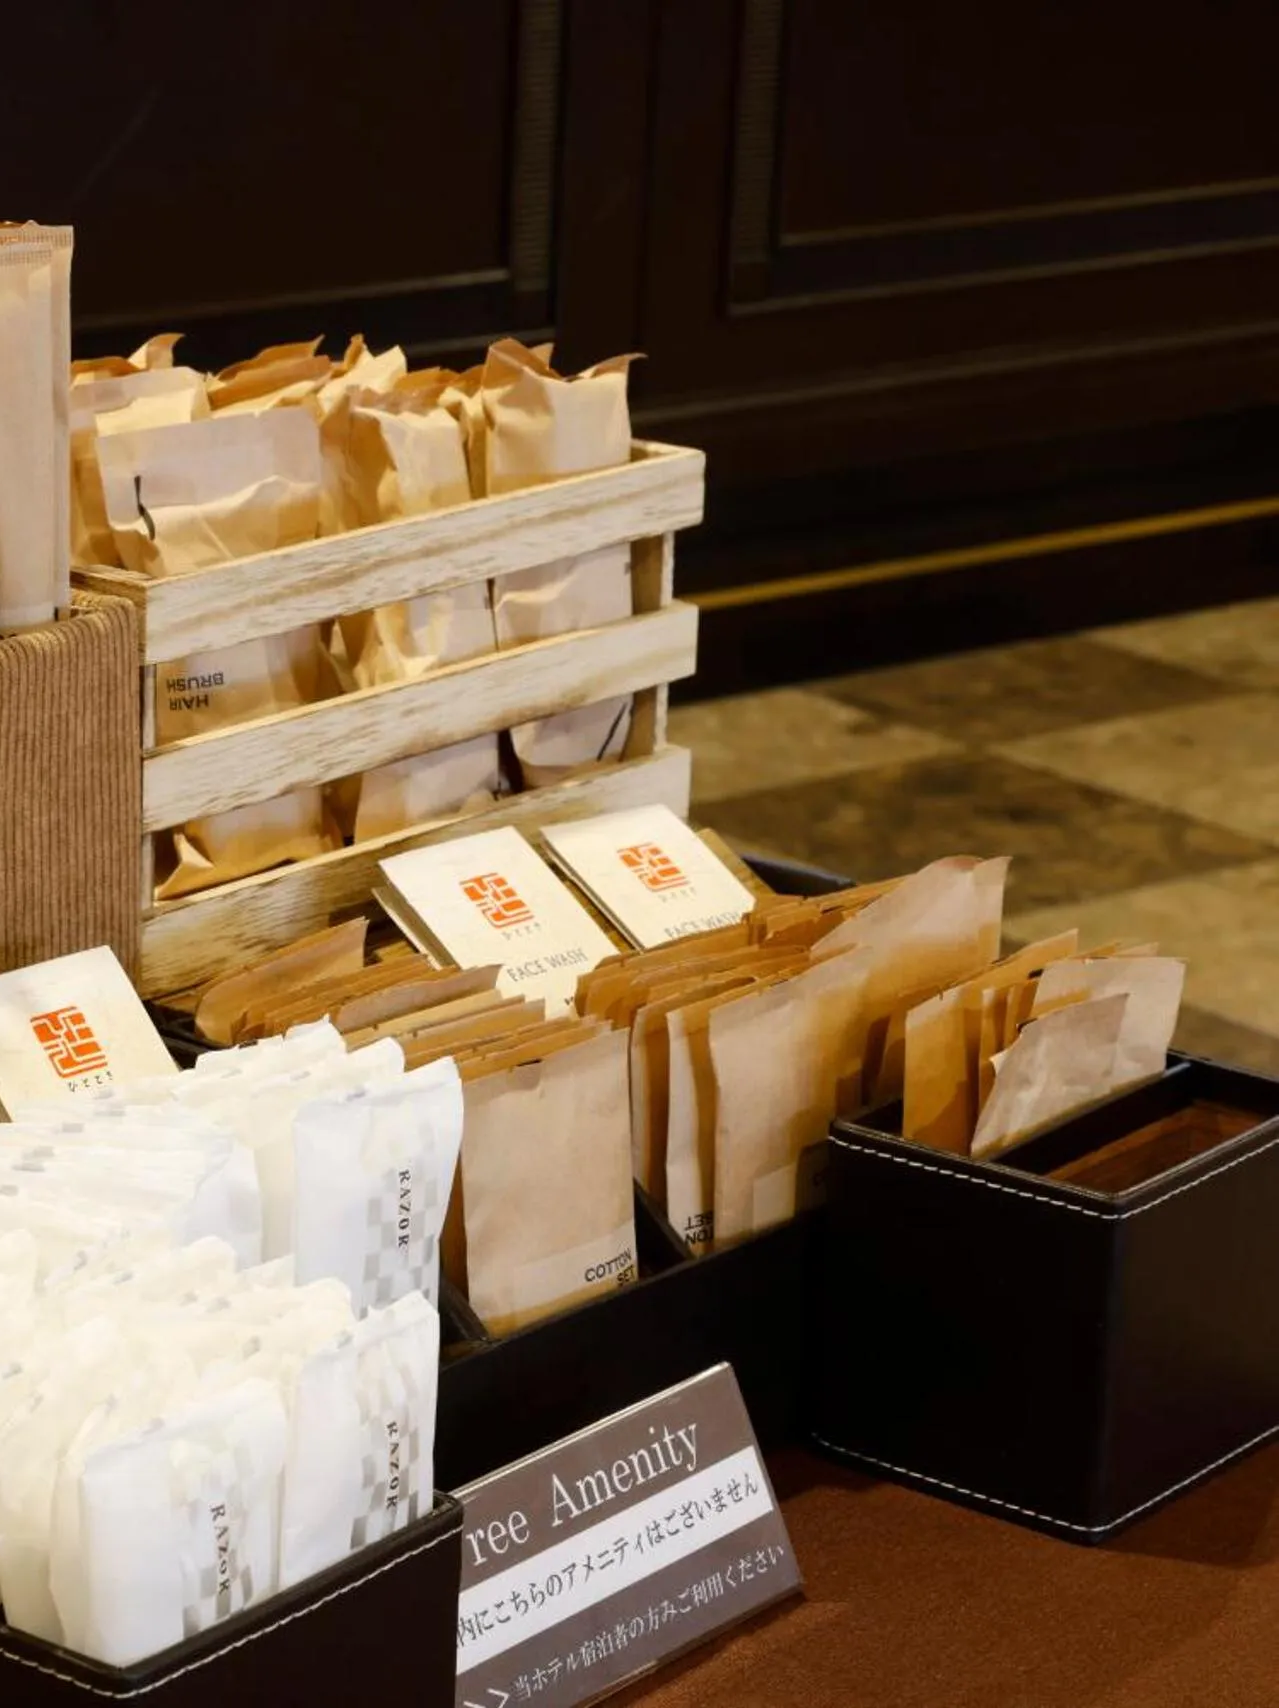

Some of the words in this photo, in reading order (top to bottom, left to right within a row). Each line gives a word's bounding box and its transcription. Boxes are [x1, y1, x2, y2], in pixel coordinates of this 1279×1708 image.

[166, 672, 224, 693] BRUSH
[169, 694, 209, 712] HAIR
[506, 958, 548, 982] FACE
[544, 947, 589, 969] WASH
[584, 1248, 632, 1282] COTTON
[616, 1264, 636, 1283] SET
[551, 1422, 698, 1529] Amenity
